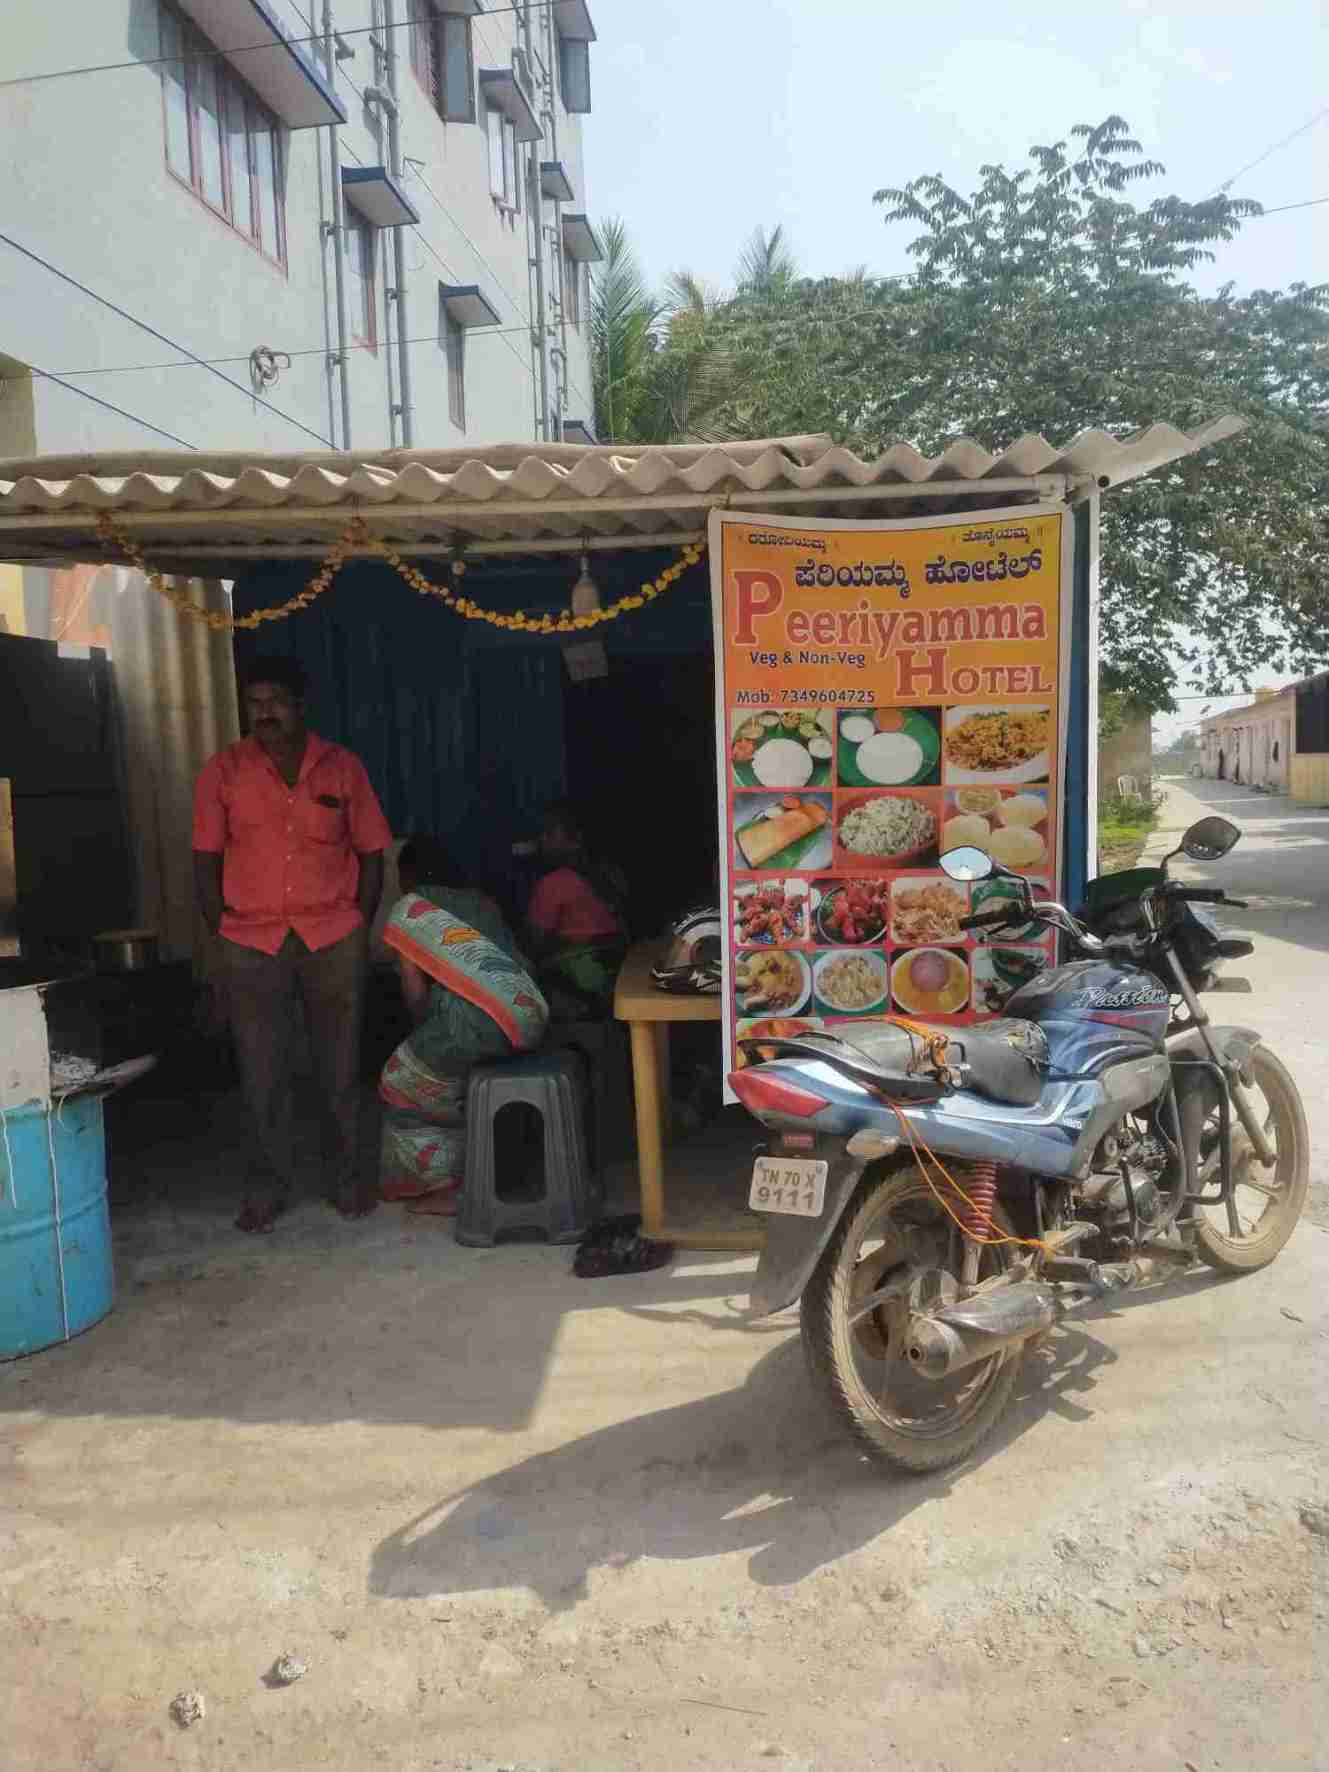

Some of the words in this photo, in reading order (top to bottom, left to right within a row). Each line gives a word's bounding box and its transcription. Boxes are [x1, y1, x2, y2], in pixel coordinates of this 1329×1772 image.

[795, 558, 911, 598] ಪೆರಿಯಮ್ಮ
[925, 547, 1042, 585] ಹೋಟೆಲ್
[733, 569, 1046, 660] Peeriyamma
[750, 651, 778, 668] Veg
[783, 651, 793, 664] &
[799, 651, 866, 668] Non-Veg
[780, 690, 875, 703] 7349604725
[759, 1168, 779, 1185] TN
[784, 1170, 801, 1187] 70
[758, 1186, 815, 1209] 9111
